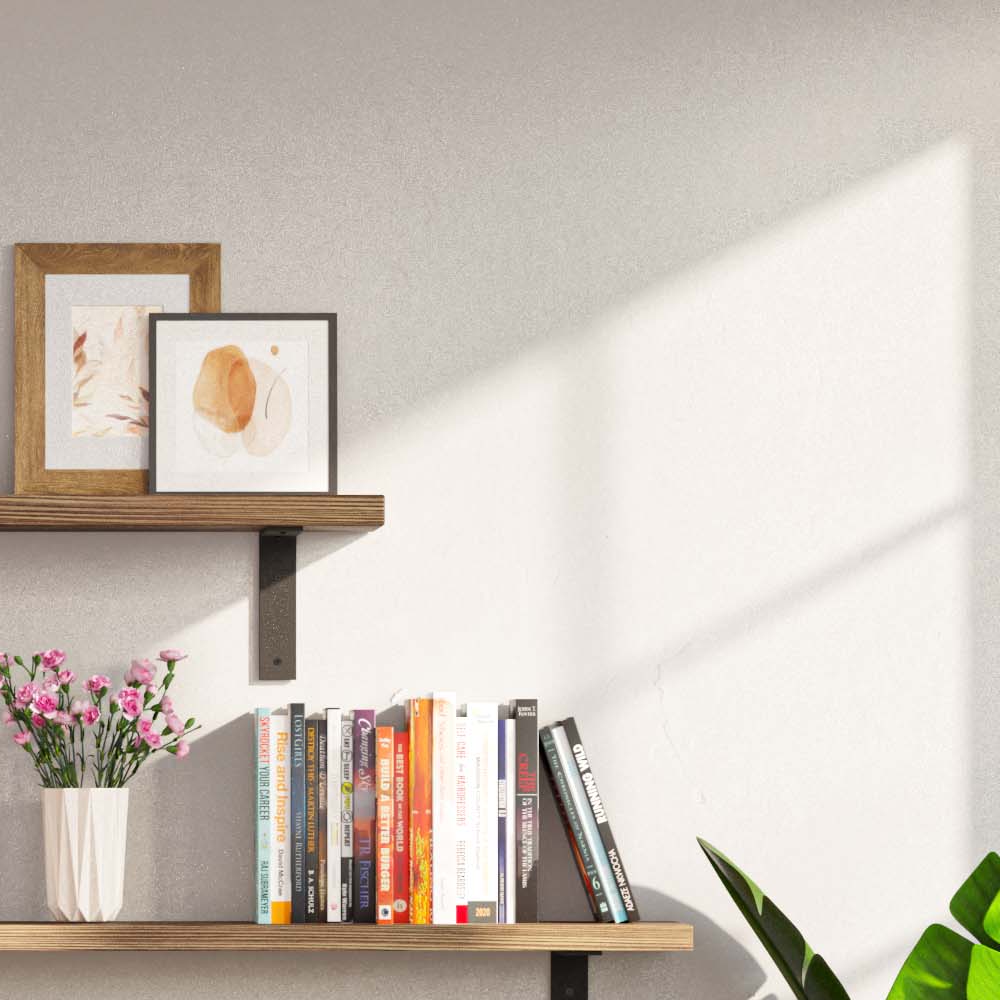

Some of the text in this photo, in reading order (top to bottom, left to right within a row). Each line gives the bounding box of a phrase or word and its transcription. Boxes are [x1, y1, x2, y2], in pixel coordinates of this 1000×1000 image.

[358, 718, 372, 768] Changing
[259, 716, 270, 821] SKYROCKET YOUR CAREER
[380, 758, 390, 791] BUILD
[396, 754, 404, 774] BEST
[274, 731, 289, 842] Rise and Inspire
[380, 794, 390, 802] A
[396, 776, 404, 802] BOOK
[572, 743, 608, 825] RUNNING WILD
[380, 805, 390, 844] BETTER
[396, 820, 404, 852] WORLD
[295, 842, 303, 892] RUTHERFORD
[380, 847, 390, 892] BURGER
[592, 875, 601, 890] 6
[619, 887, 635, 912] ADAEZE
